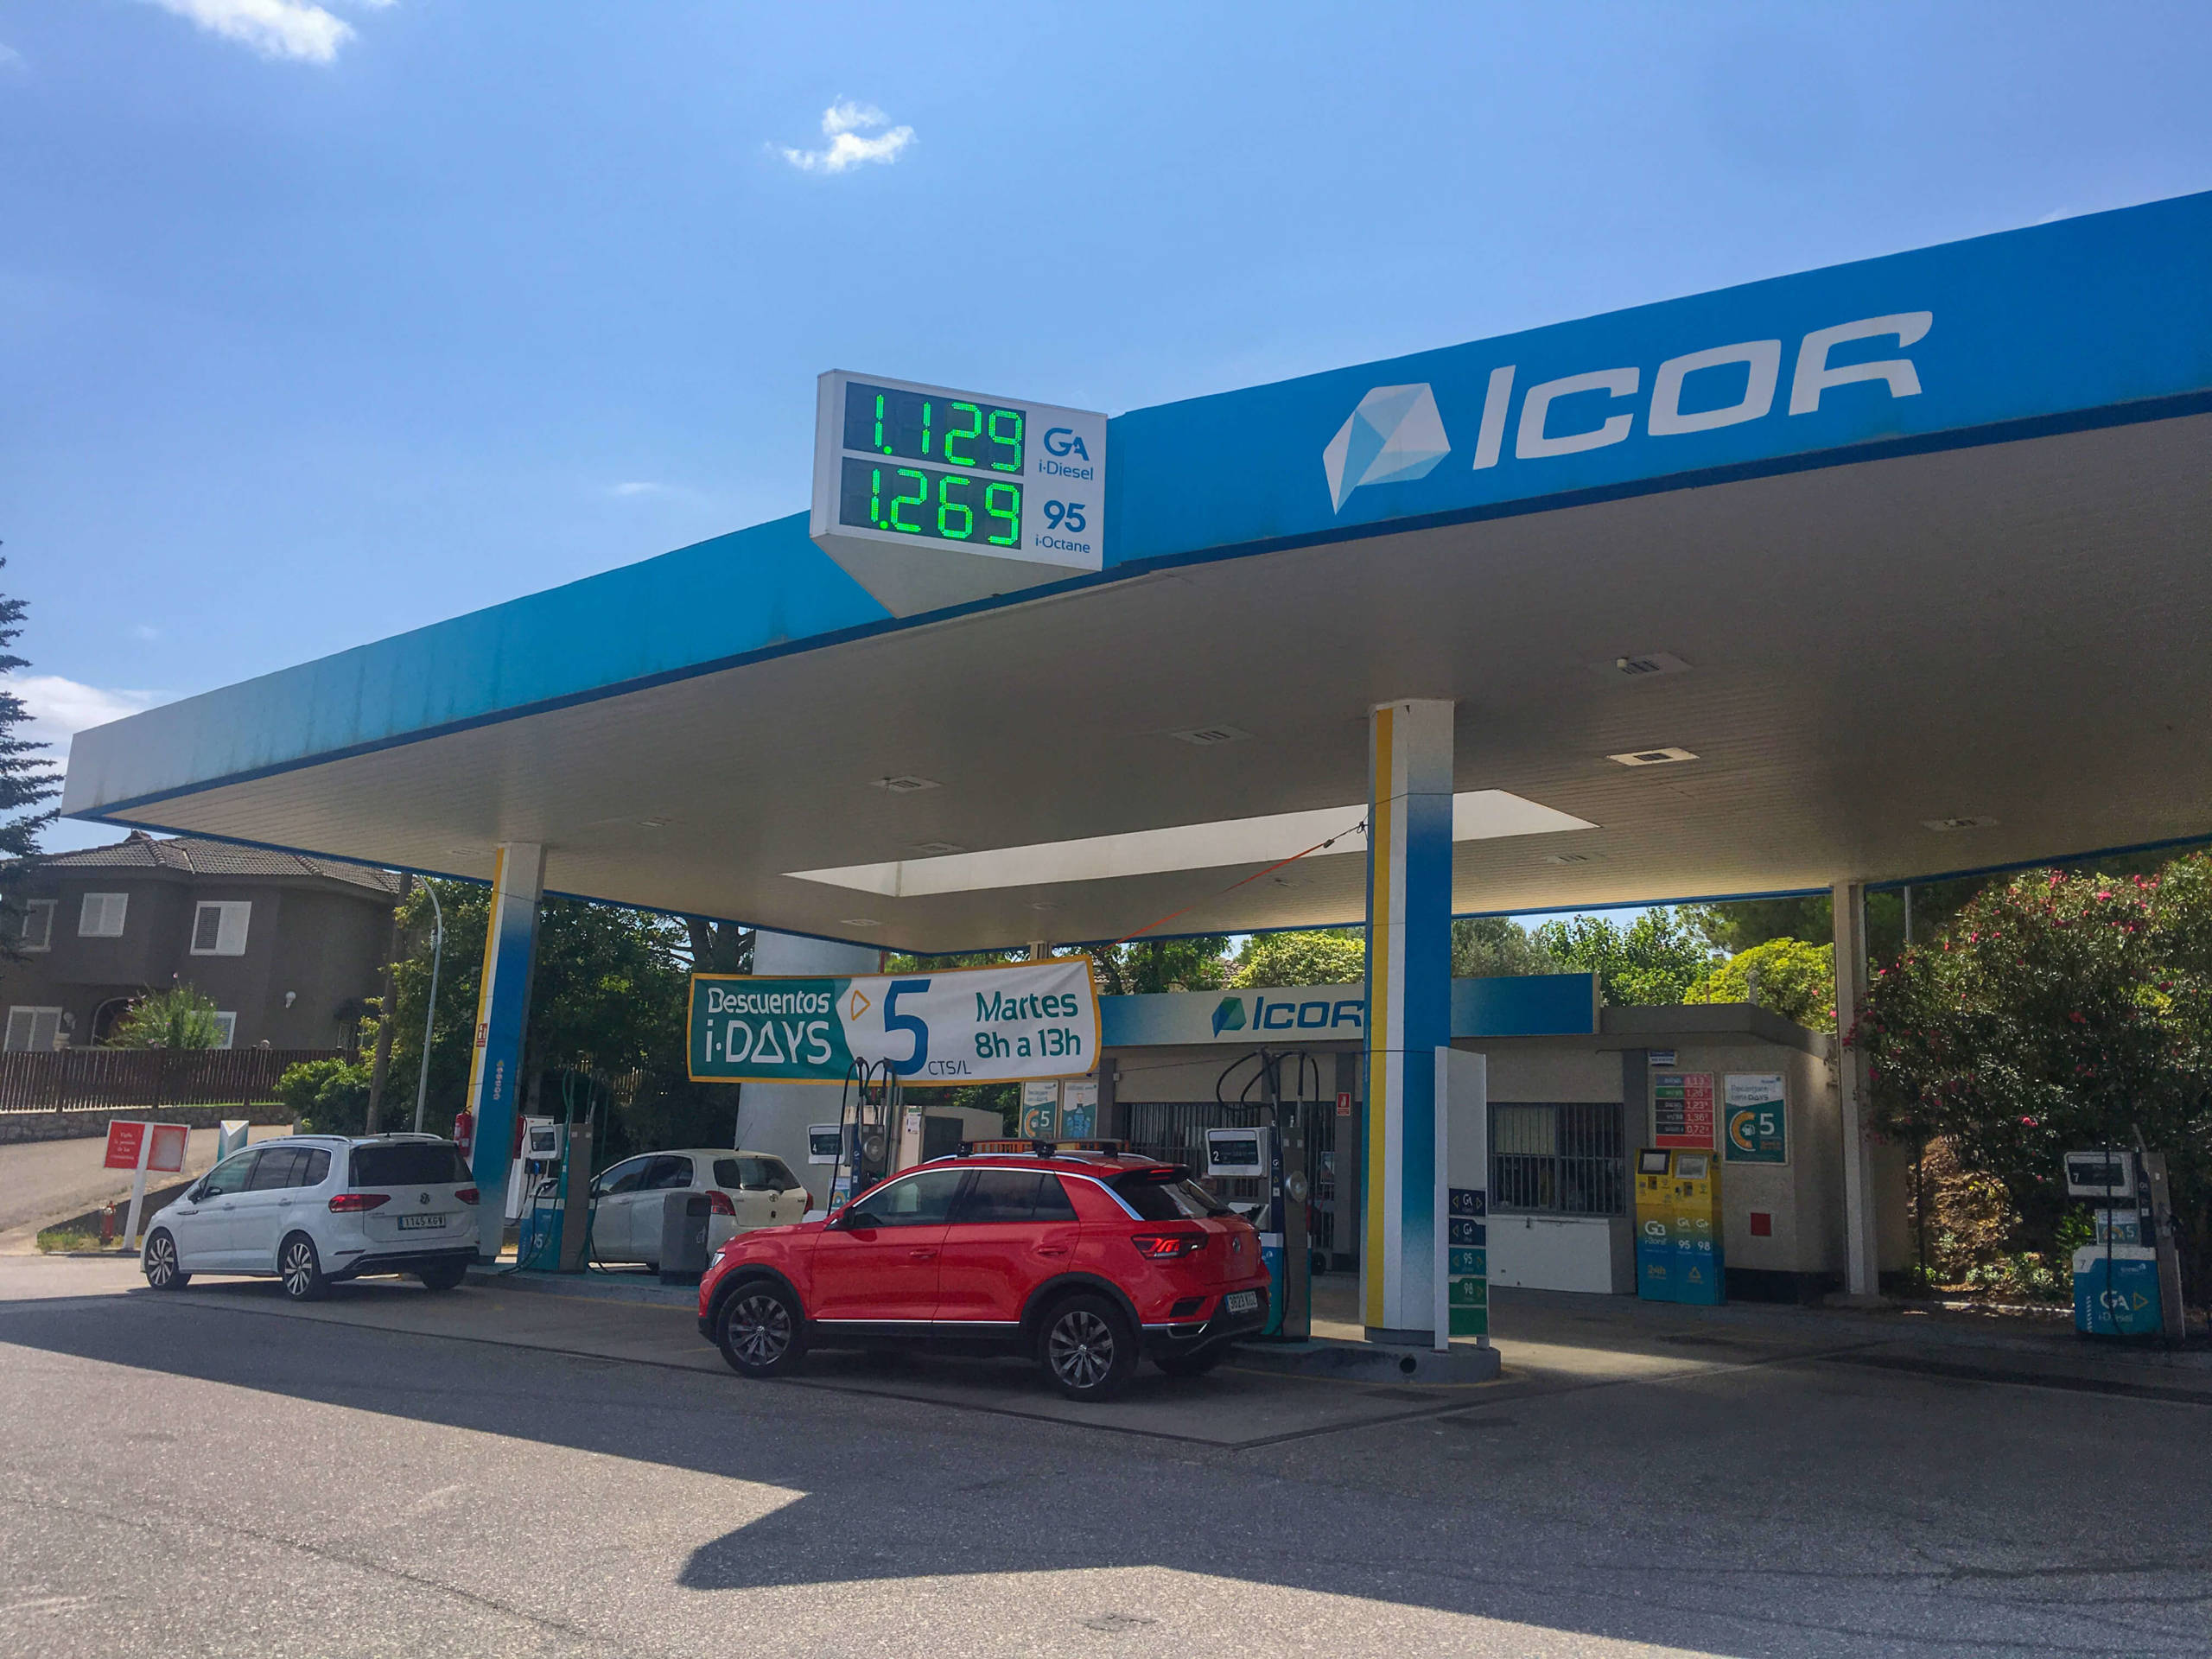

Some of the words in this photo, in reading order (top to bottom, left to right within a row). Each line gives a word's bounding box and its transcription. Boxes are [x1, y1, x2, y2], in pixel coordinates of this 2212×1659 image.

[1472, 311, 1933, 469] ICOR
[874, 393, 1023, 472] 1.129
[1043, 427, 1090, 461] GA
[870, 467, 1020, 546] 1.269
[1043, 499, 1086, 533] 95
[707, 987, 831, 1015] Descuentos
[976, 991, 1079, 1022] Martes
[1252, 995, 1364, 1031] ICOR
[884, 978, 932, 1076] 5
[975, 1031, 1011, 1059] 8h
[1015, 1035, 1032, 1058] a
[1038, 1028, 1082, 1057] 13h
[927, 1059, 973, 1076] CTS/L
[1040, 1110, 1050, 1128] 5
[1759, 1112, 1775, 1136] 5
[1212, 1151, 1220, 1161] 2
[2074, 1173, 2080, 1183] 7
[1463, 1252, 1473, 1265] 95
[1678, 1239, 1691, 1250] 95
[1697, 1241, 1711, 1251] 98
